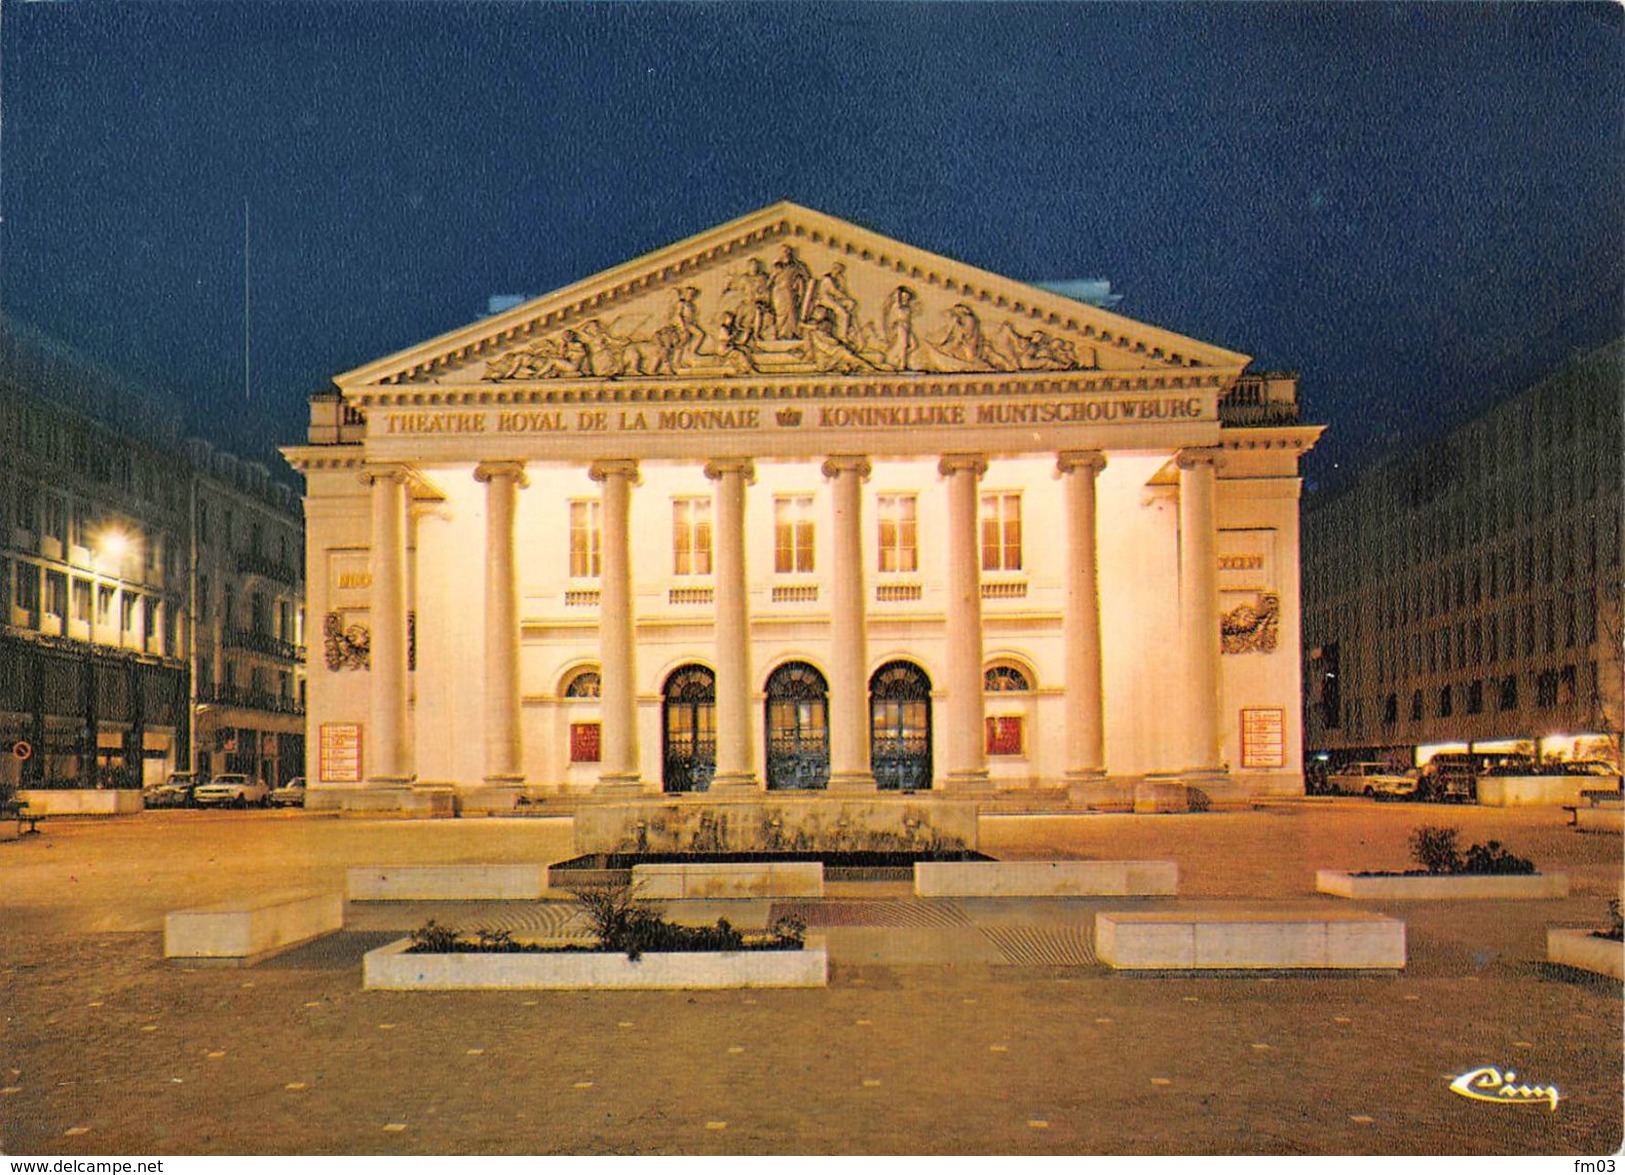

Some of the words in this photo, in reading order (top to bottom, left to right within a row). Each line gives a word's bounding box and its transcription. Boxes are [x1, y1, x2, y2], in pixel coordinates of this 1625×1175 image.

[386, 411, 488, 434] THEATRE
[497, 410, 569, 433] ROYAL
[576, 409, 609, 431] DE
[617, 409, 648, 431] LA
[657, 408, 761, 430] MONNAIE
[818, 405, 966, 429] KONINKLIJKE
[976, 398, 1202, 424] MUNTSCHOUWBURG
